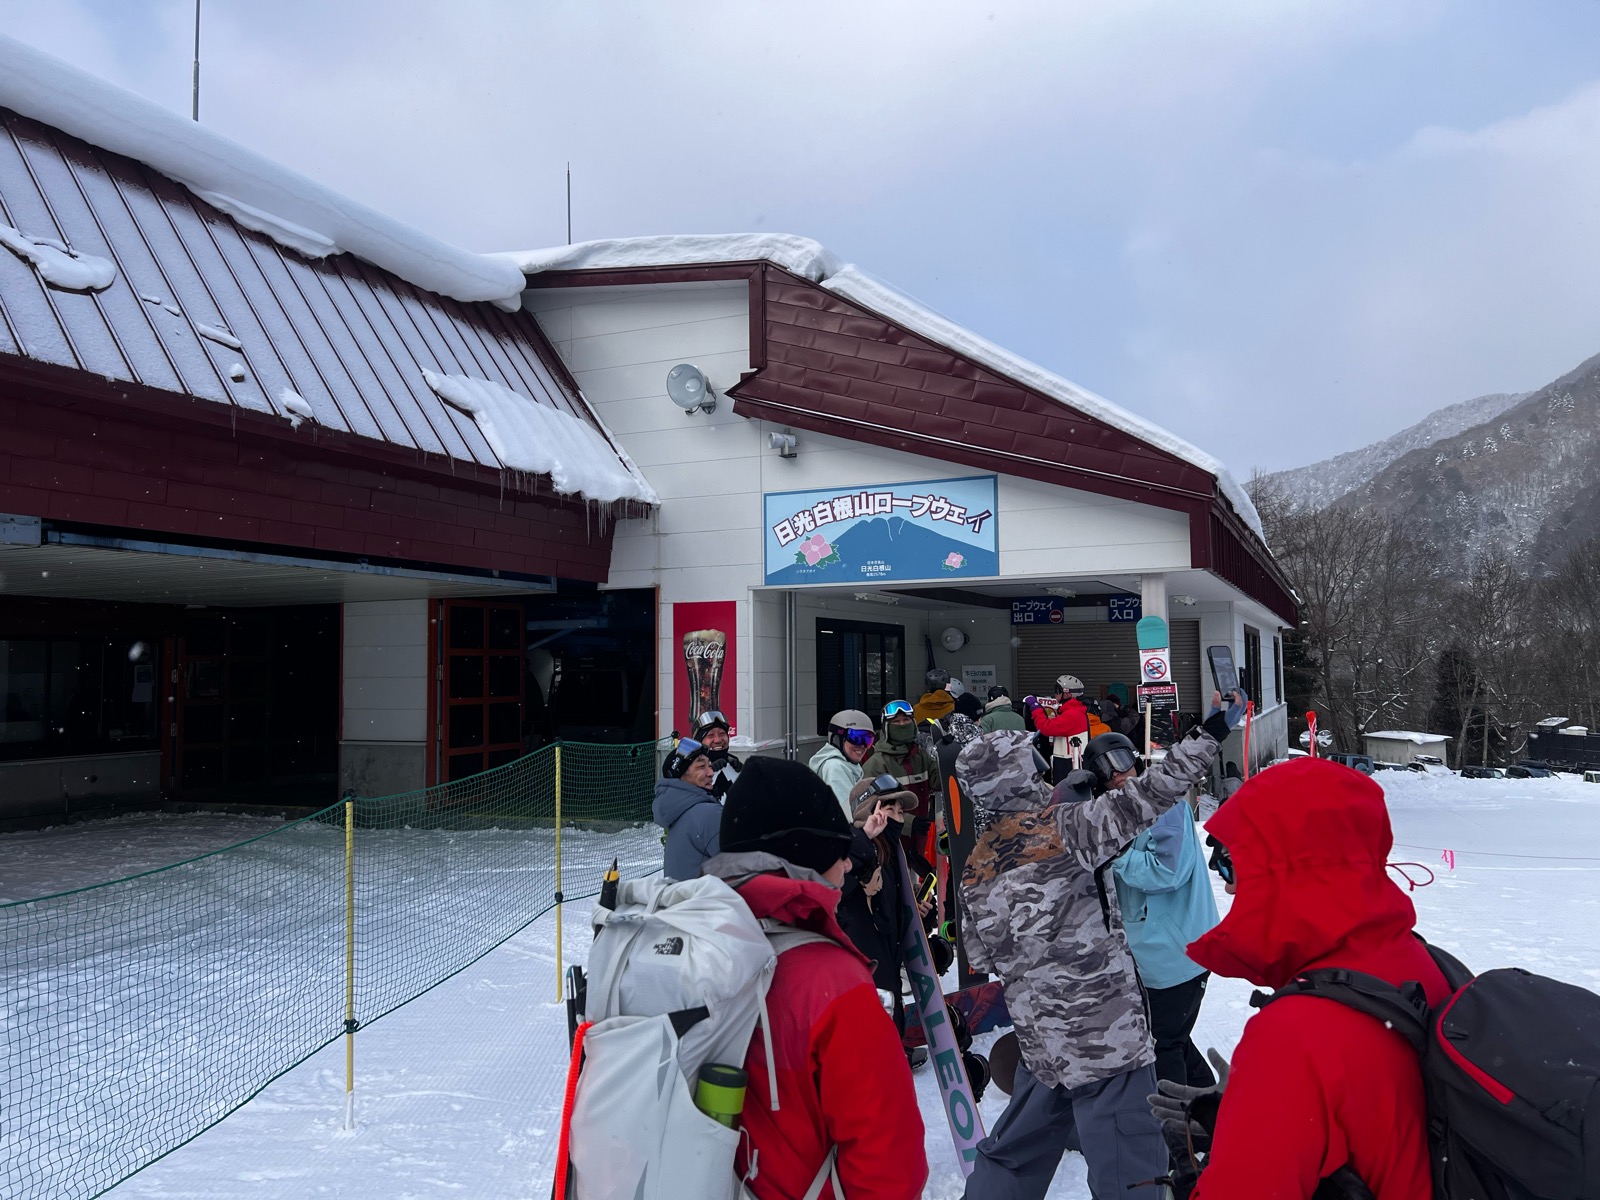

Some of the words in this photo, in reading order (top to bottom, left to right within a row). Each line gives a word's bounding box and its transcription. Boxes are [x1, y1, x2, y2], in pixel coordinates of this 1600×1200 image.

[860, 564, 892, 573] 日光白根山
[1012, 599, 1054, 611] ロープウェイ
[1013, 612, 1034, 623] 出口
[1111, 609, 1134, 620] 入口
[685, 641, 725, 659] Coca-Cola
[1039, 698, 1057, 706] STOP
